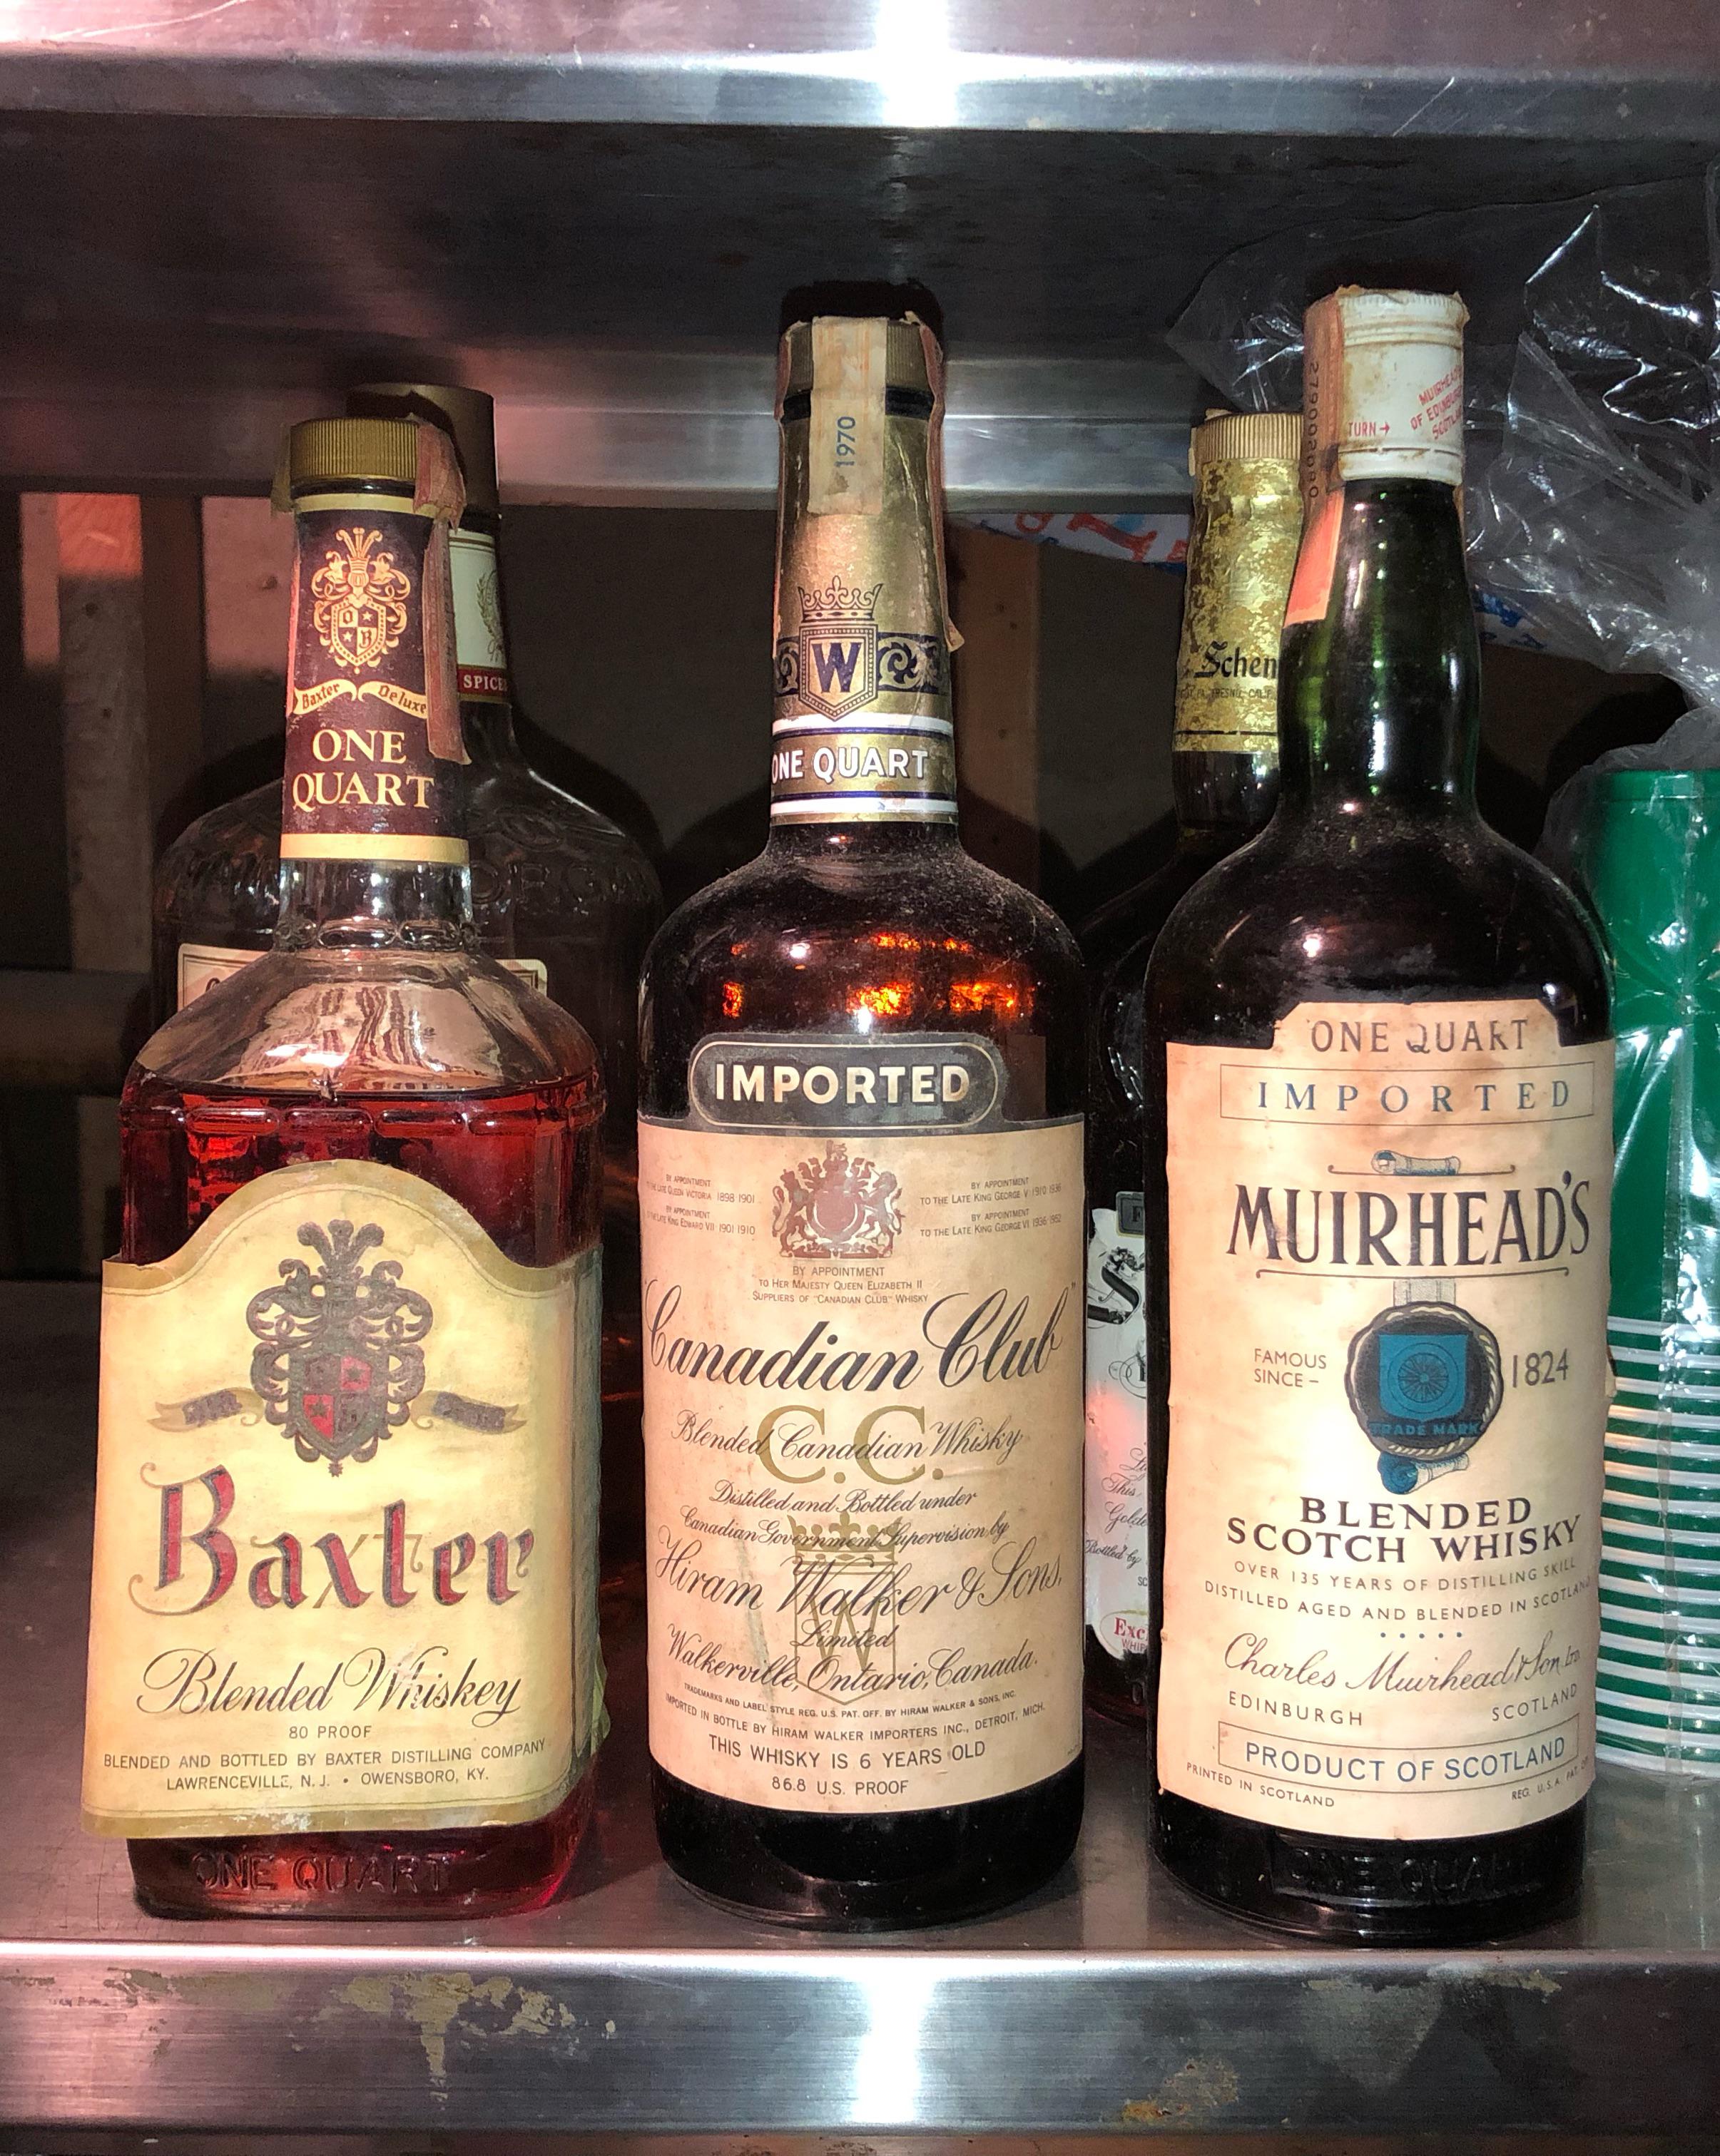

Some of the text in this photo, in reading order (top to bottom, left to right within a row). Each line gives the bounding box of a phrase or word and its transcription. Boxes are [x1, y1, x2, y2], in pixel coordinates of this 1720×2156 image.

[1348, 422, 1376, 436] TURN
[1410, 413, 1423, 431] OF
[835, 416, 855, 468] 1970
[812, 642, 862, 693] W
[302, 683, 427, 713] Baxter Deluxe
[312, 729, 407, 764] ONE
[772, 747, 928, 784] ONE QUART
[292, 772, 434, 812] QUART
[1311, 1018, 1530, 1054] ONE QUART
[715, 1064, 970, 1104] IMPORTED
[1257, 1080, 1570, 1113] IMPORTED
[674, 1175, 711, 1187] APPOINTMENT
[984, 1177, 1029, 1189] APPOINTMENT
[673, 1207, 711, 1219] APPOINTMENT
[920, 1197, 931, 1205] TO
[932, 1196, 948, 1205] THE
[984, 1208, 1029, 1220] APPOINTMENT
[935, 1228, 949, 1237] THE
[1226, 1170, 1590, 1267] MUIRHEAD'S
[759, 1279, 769, 1288] TO
[793, 1266, 885, 1277] BY APPOINTMENT
[645, 1279, 924, 1391] Canadian
[1254, 1348, 1327, 1370] FAMOUS
[1512, 1347, 1569, 1389] 1824
[671, 1409, 1023, 1466] Blended Canadian Whisky
[709, 1479, 977, 1513] Distilled and Bottled under
[1101, 1472, 1136, 1496] This
[680, 1506, 1009, 1553] Canadian Government Supervision by
[1300, 1496, 1532, 1529] BLENDED
[129, 1464, 534, 1615] Baxter
[1227, 1515, 1581, 1564] SCOTCH WHISKY
[656, 1525, 763, 1610] Hiram
[776, 1555, 957, 1617] Walker
[1234, 1558, 1576, 1591] OVER 135 YEARS OF DISTILLING SKILL
[1205, 1580, 1288, 1610] DISTILLED
[1298, 1601, 1351, 1618] AGED
[1362, 1608, 1405, 1620] AND
[1418, 1603, 1502, 1620] BLENDED
[1510, 1600, 1526, 1613] IN
[790, 1619, 900, 1647] Limited
[1225, 1633, 1336, 1688] Charles
[1345, 1647, 1520, 1692] Muirhead
[136, 1645, 521, 1728] Blended Whiskey
[684, 1682, 723, 1703] TRADEMARKS
[725, 1697, 740, 1707] AND
[743, 1701, 767, 1712] LABEL
[770, 1705, 795, 1715] STYLE
[799, 1709, 818, 1717] REG.
[900, 1707, 929, 1716] HIRAM
[932, 1701, 966, 1713] WALKER
[1492, 1683, 1577, 1722] SCOTLAND
[666, 1692, 697, 1717] IMPORTED
[701, 1710, 709, 1721] IN
[713, 1714, 748, 1731] BOTTLE
[753, 1723, 766, 1734] BY
[772, 1727, 808, 1739] HIRAM
[814, 1730, 863, 1741] WALKER
[870, 1727, 937, 1740] IMPORTERS
[1229, 1691, 1362, 1726] EDINBURGH
[289, 1725, 372, 1739] 80 PROOF
[104, 1737, 545, 1769] BLENDED AND BOTTLED BY BAXTER DISTILLING COMPANY
[708, 1734, 986, 1769] THIS WHISKY IS 6 YEARS OLD
[1246, 1737, 1564, 1782] PRODUCT OF SCOTLAND
[167, 1768, 489, 1790] LAWRENCEVILLE, OWENSBORO, KY.
[772, 1776, 909, 1796] 86.8 U.S. PROOF
[1186, 1762, 1335, 1807] PRINTED IN SCOTLAND
[193, 1853, 449, 1893] ONE QUART
